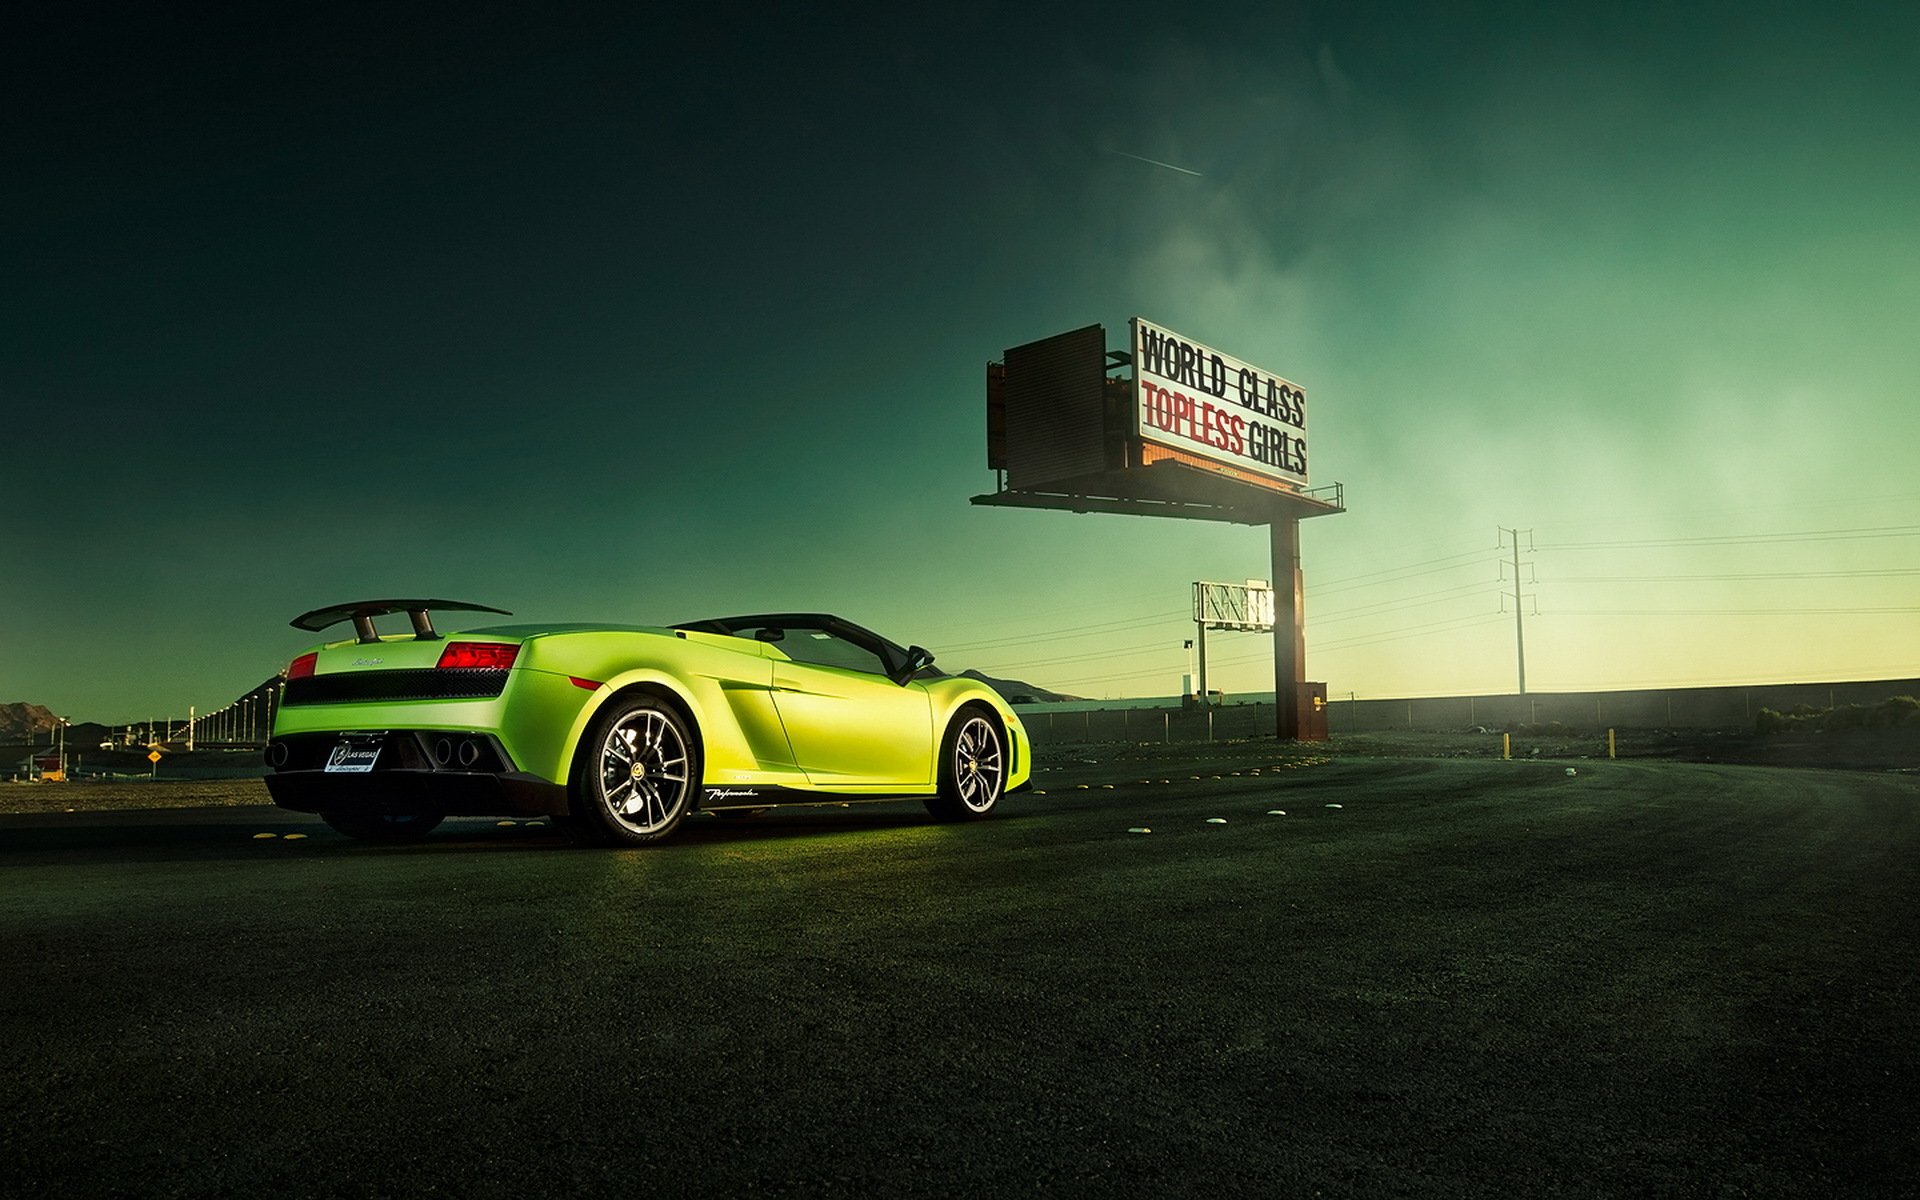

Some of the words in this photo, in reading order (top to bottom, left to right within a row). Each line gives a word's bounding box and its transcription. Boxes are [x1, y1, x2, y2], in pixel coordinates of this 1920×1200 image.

[1141, 325, 1226, 399] WORLD
[1239, 368, 1304, 428] CLASS
[1142, 380, 1245, 456] TOPLESS
[1249, 420, 1307, 476] GIRLS
[347, 751, 357, 759] LAS
[358, 751, 377, 759] VEGAS
